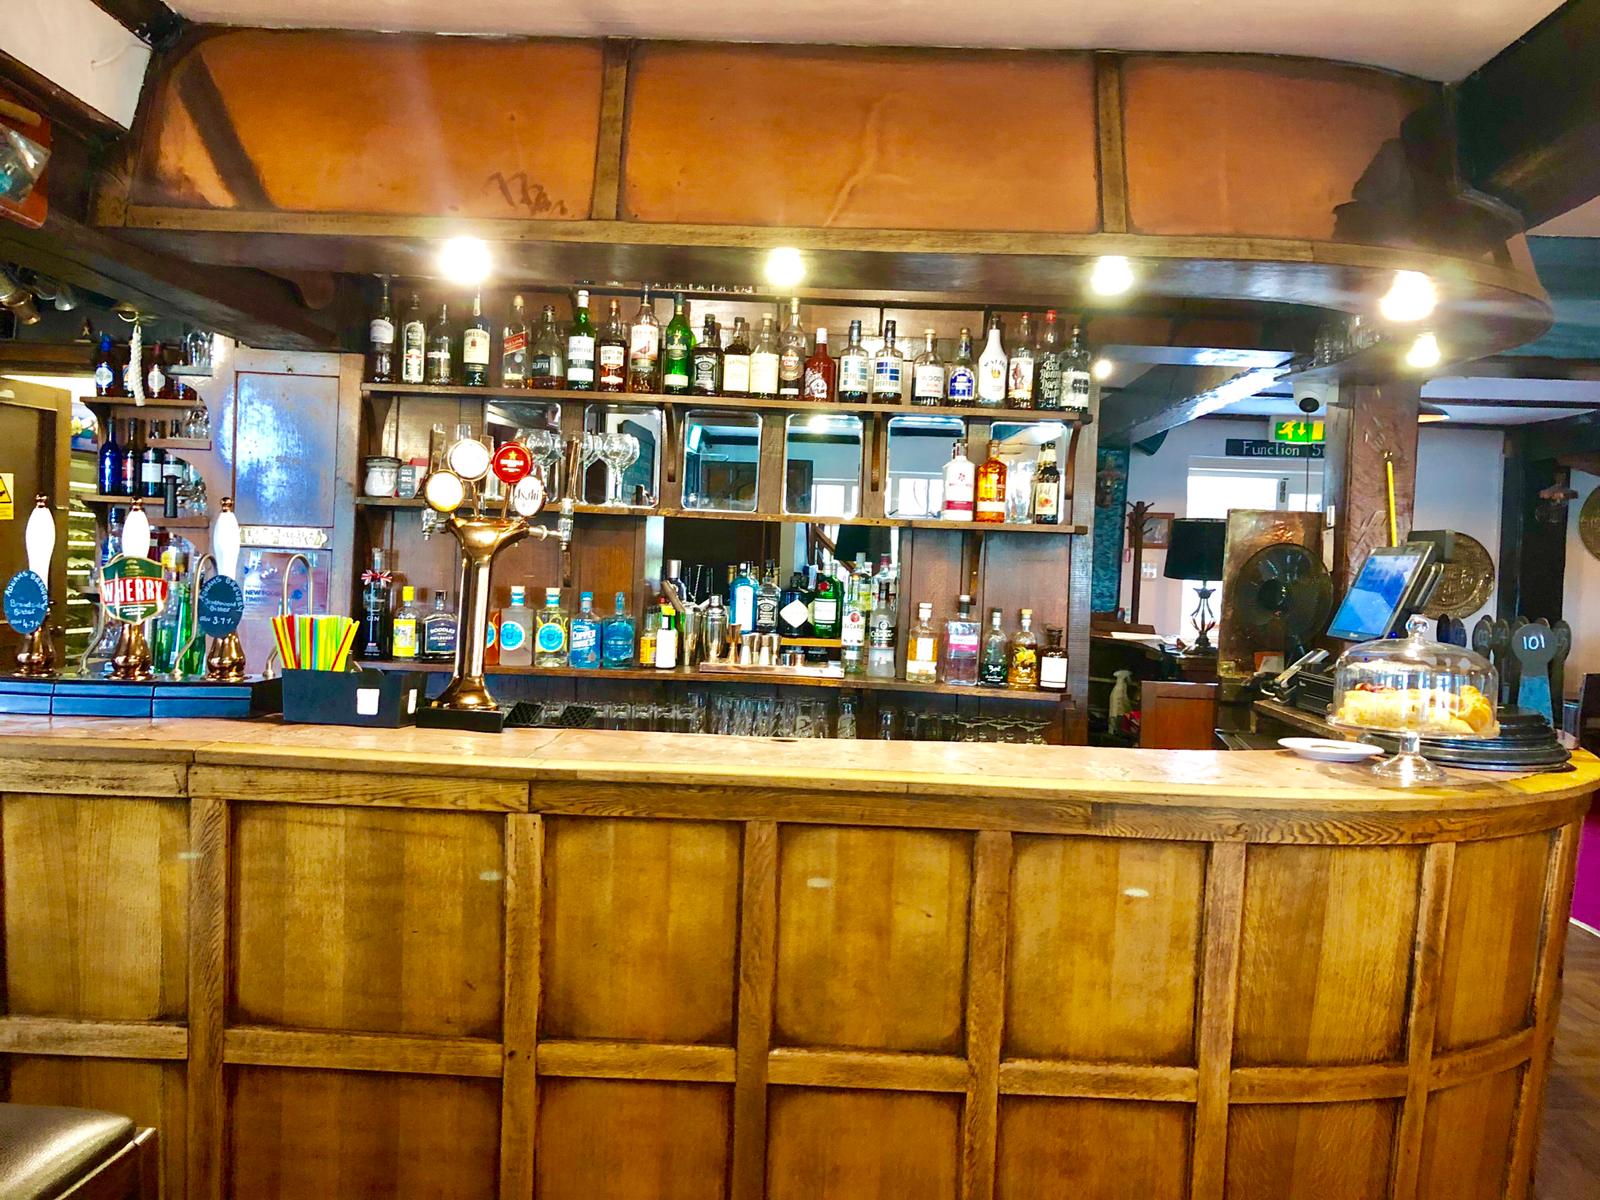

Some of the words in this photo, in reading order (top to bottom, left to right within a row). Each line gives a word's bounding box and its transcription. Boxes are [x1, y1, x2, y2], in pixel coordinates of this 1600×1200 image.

[1242, 441, 1300, 456] Function
[1312, 443, 1325, 456] S
[102, 577, 163, 604] WHERRY
[1523, 633, 1546, 650] 101
